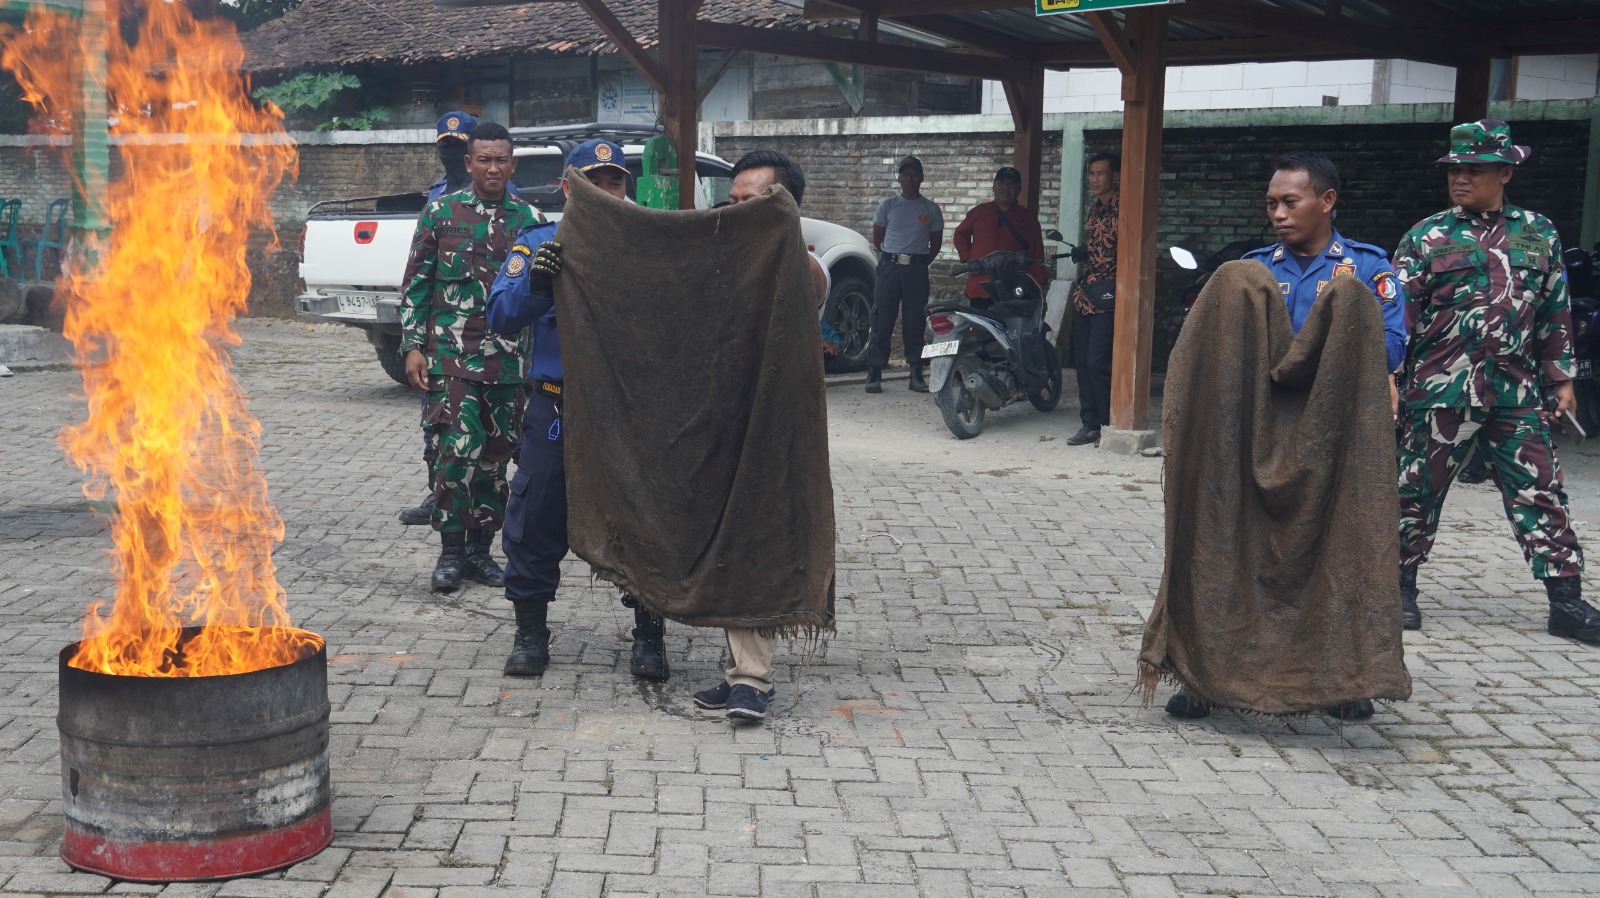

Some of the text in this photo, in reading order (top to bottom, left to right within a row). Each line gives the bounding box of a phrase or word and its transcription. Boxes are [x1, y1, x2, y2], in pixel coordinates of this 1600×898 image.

[440, 226, 471, 234] ARIES
[338, 296, 345, 306] L
[345, 295, 366, 308] 8457
